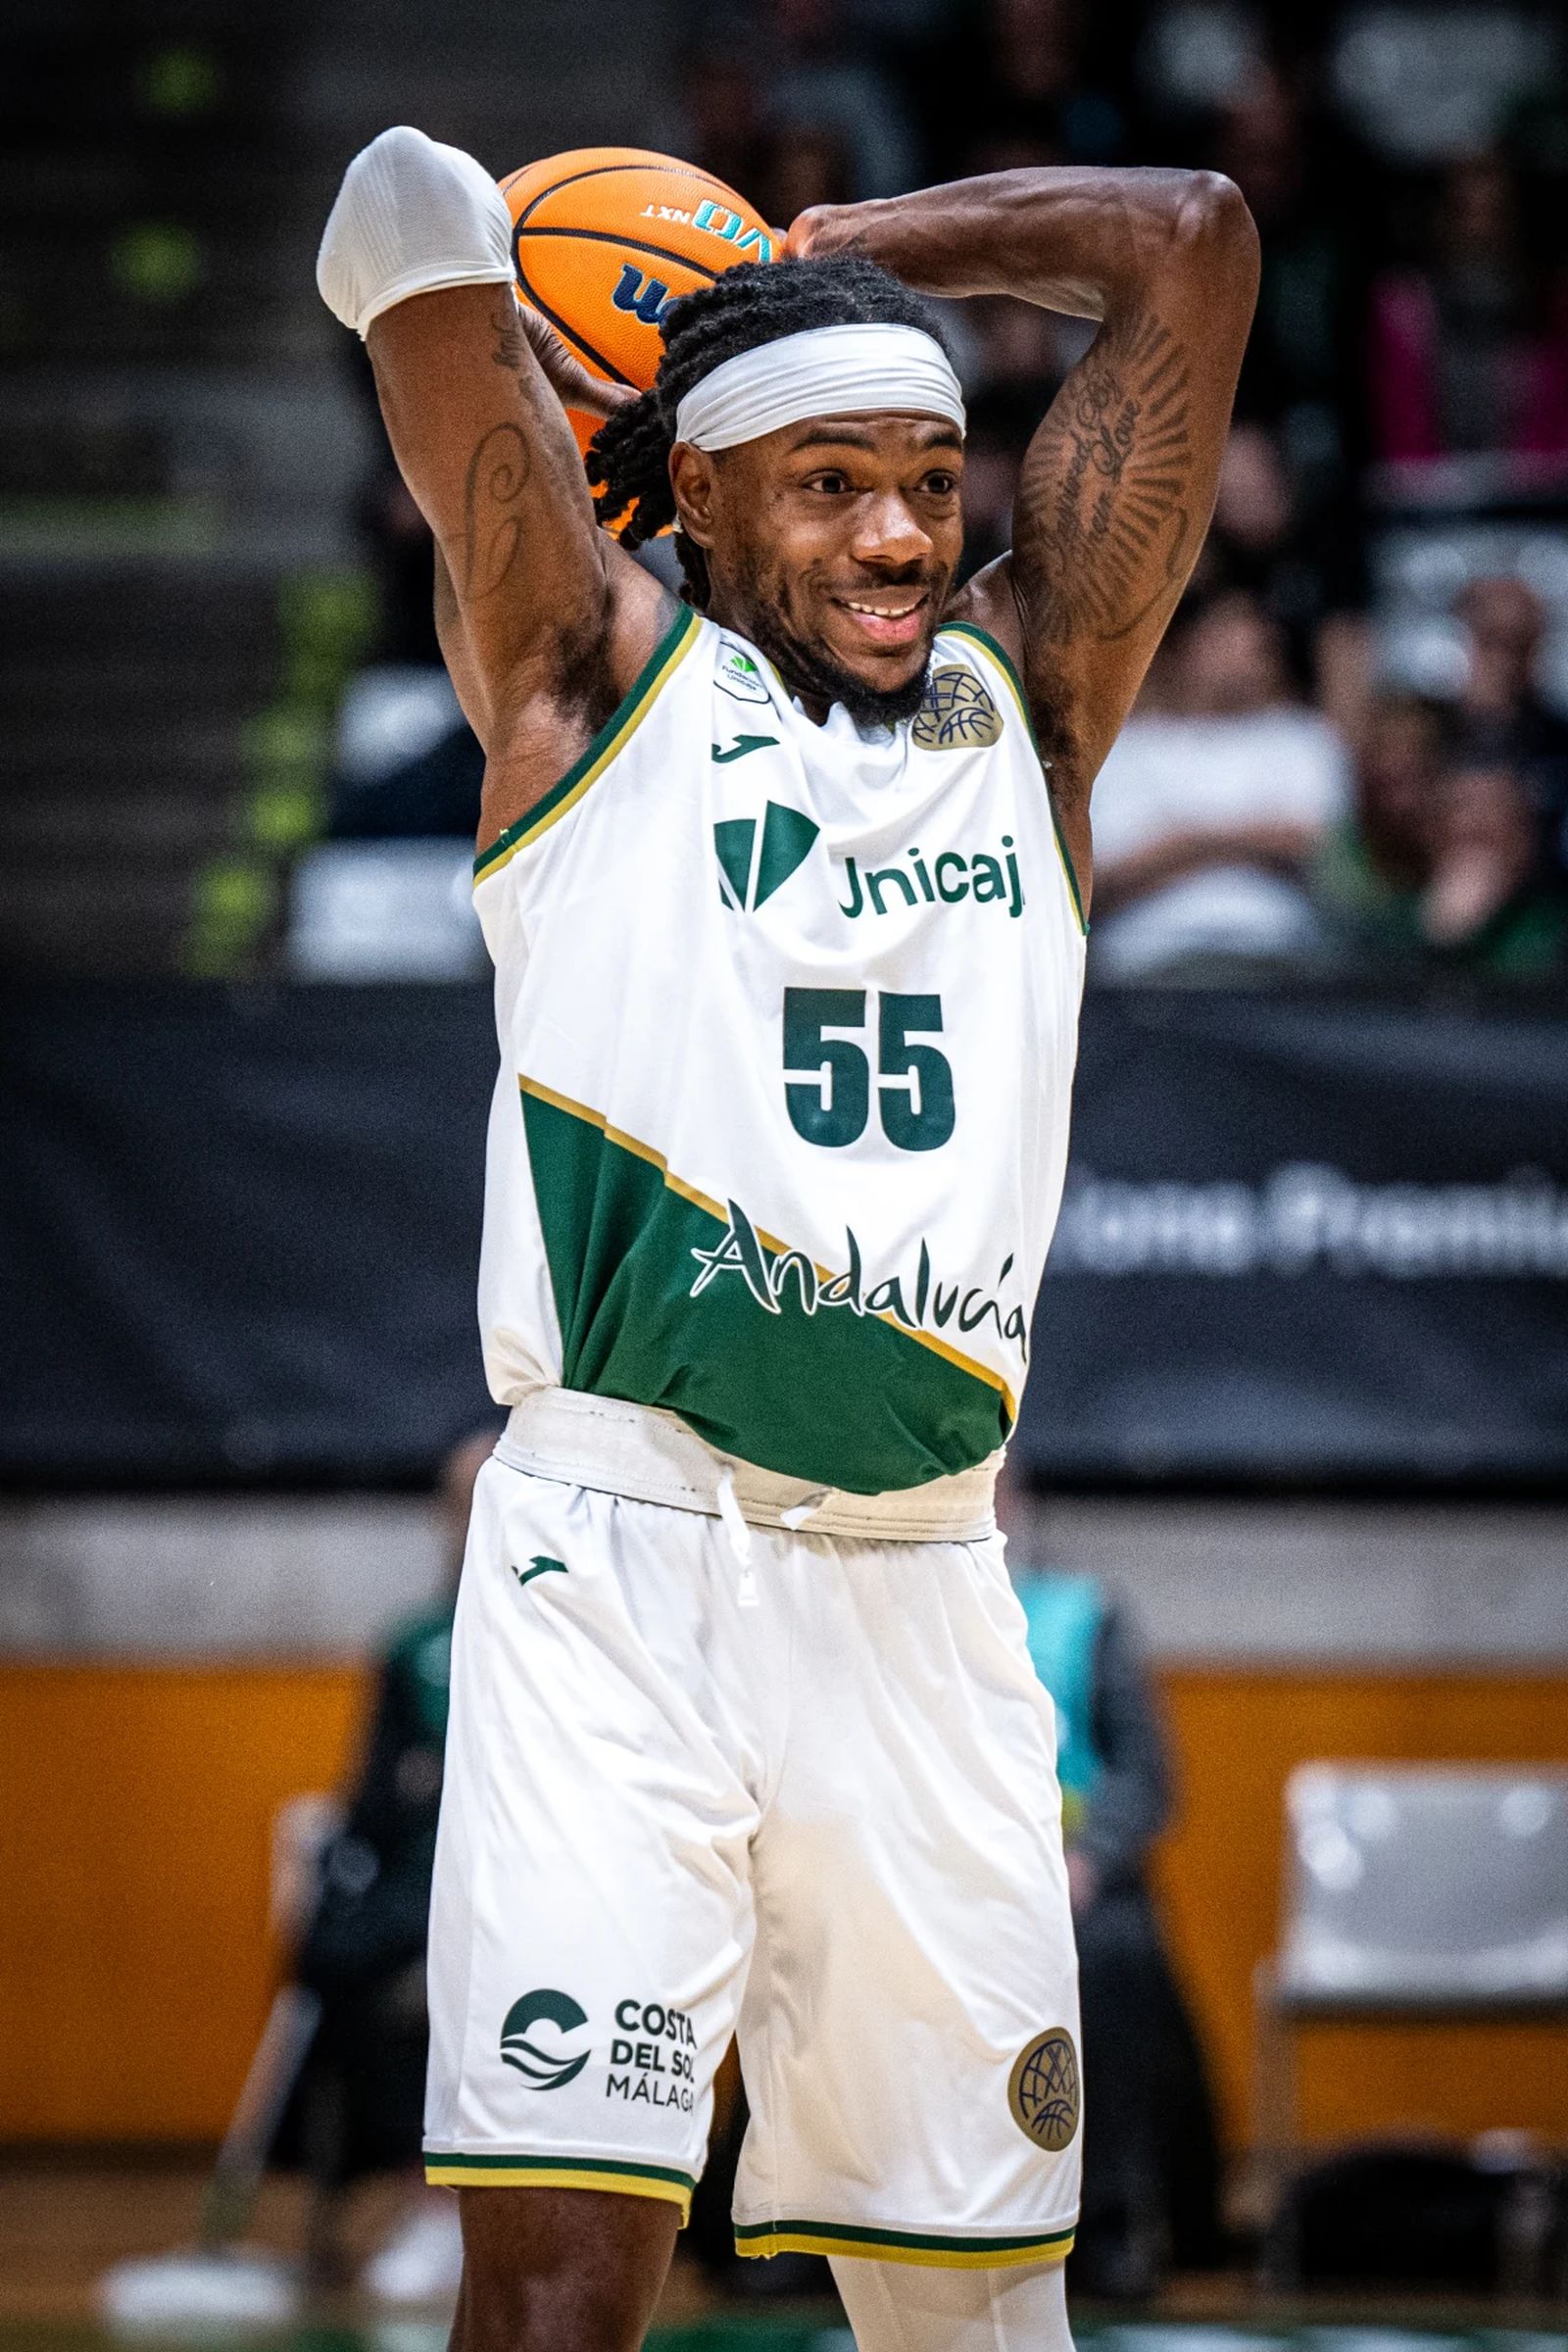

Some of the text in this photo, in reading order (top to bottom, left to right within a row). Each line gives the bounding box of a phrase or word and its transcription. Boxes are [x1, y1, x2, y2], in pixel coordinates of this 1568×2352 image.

[639, 198, 774, 263] VO NXT
[1088, 398, 1142, 486] Love
[838, 835, 1026, 919] Unicaj
[782, 986, 956, 1152] 55
[690, 1197, 1028, 1365] Andalucía
[610, 2037, 665, 2073] DEL
[613, 1998, 698, 2050] COSTA
